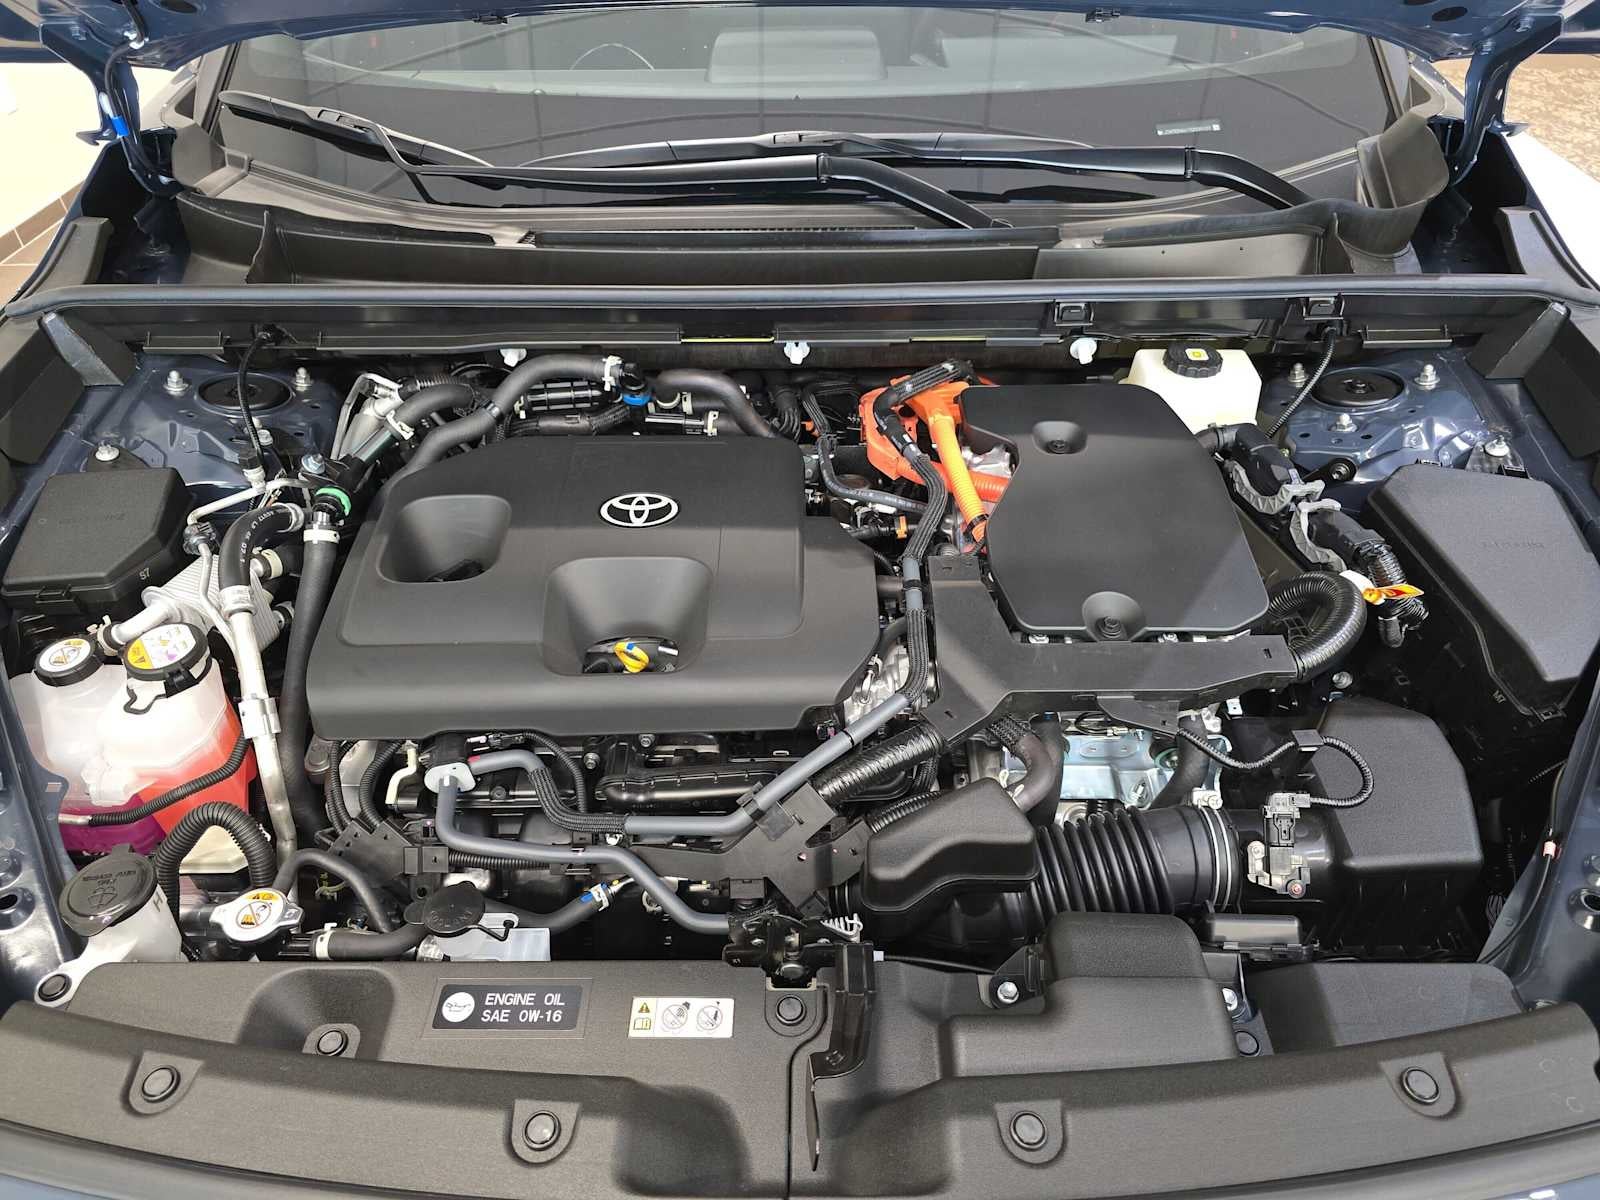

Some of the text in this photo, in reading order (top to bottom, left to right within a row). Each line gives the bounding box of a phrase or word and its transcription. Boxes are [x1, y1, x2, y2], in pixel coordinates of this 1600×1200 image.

[484, 993, 566, 1006] ENGINE OIL
[480, 1009, 563, 1023] SAE 0W-16
